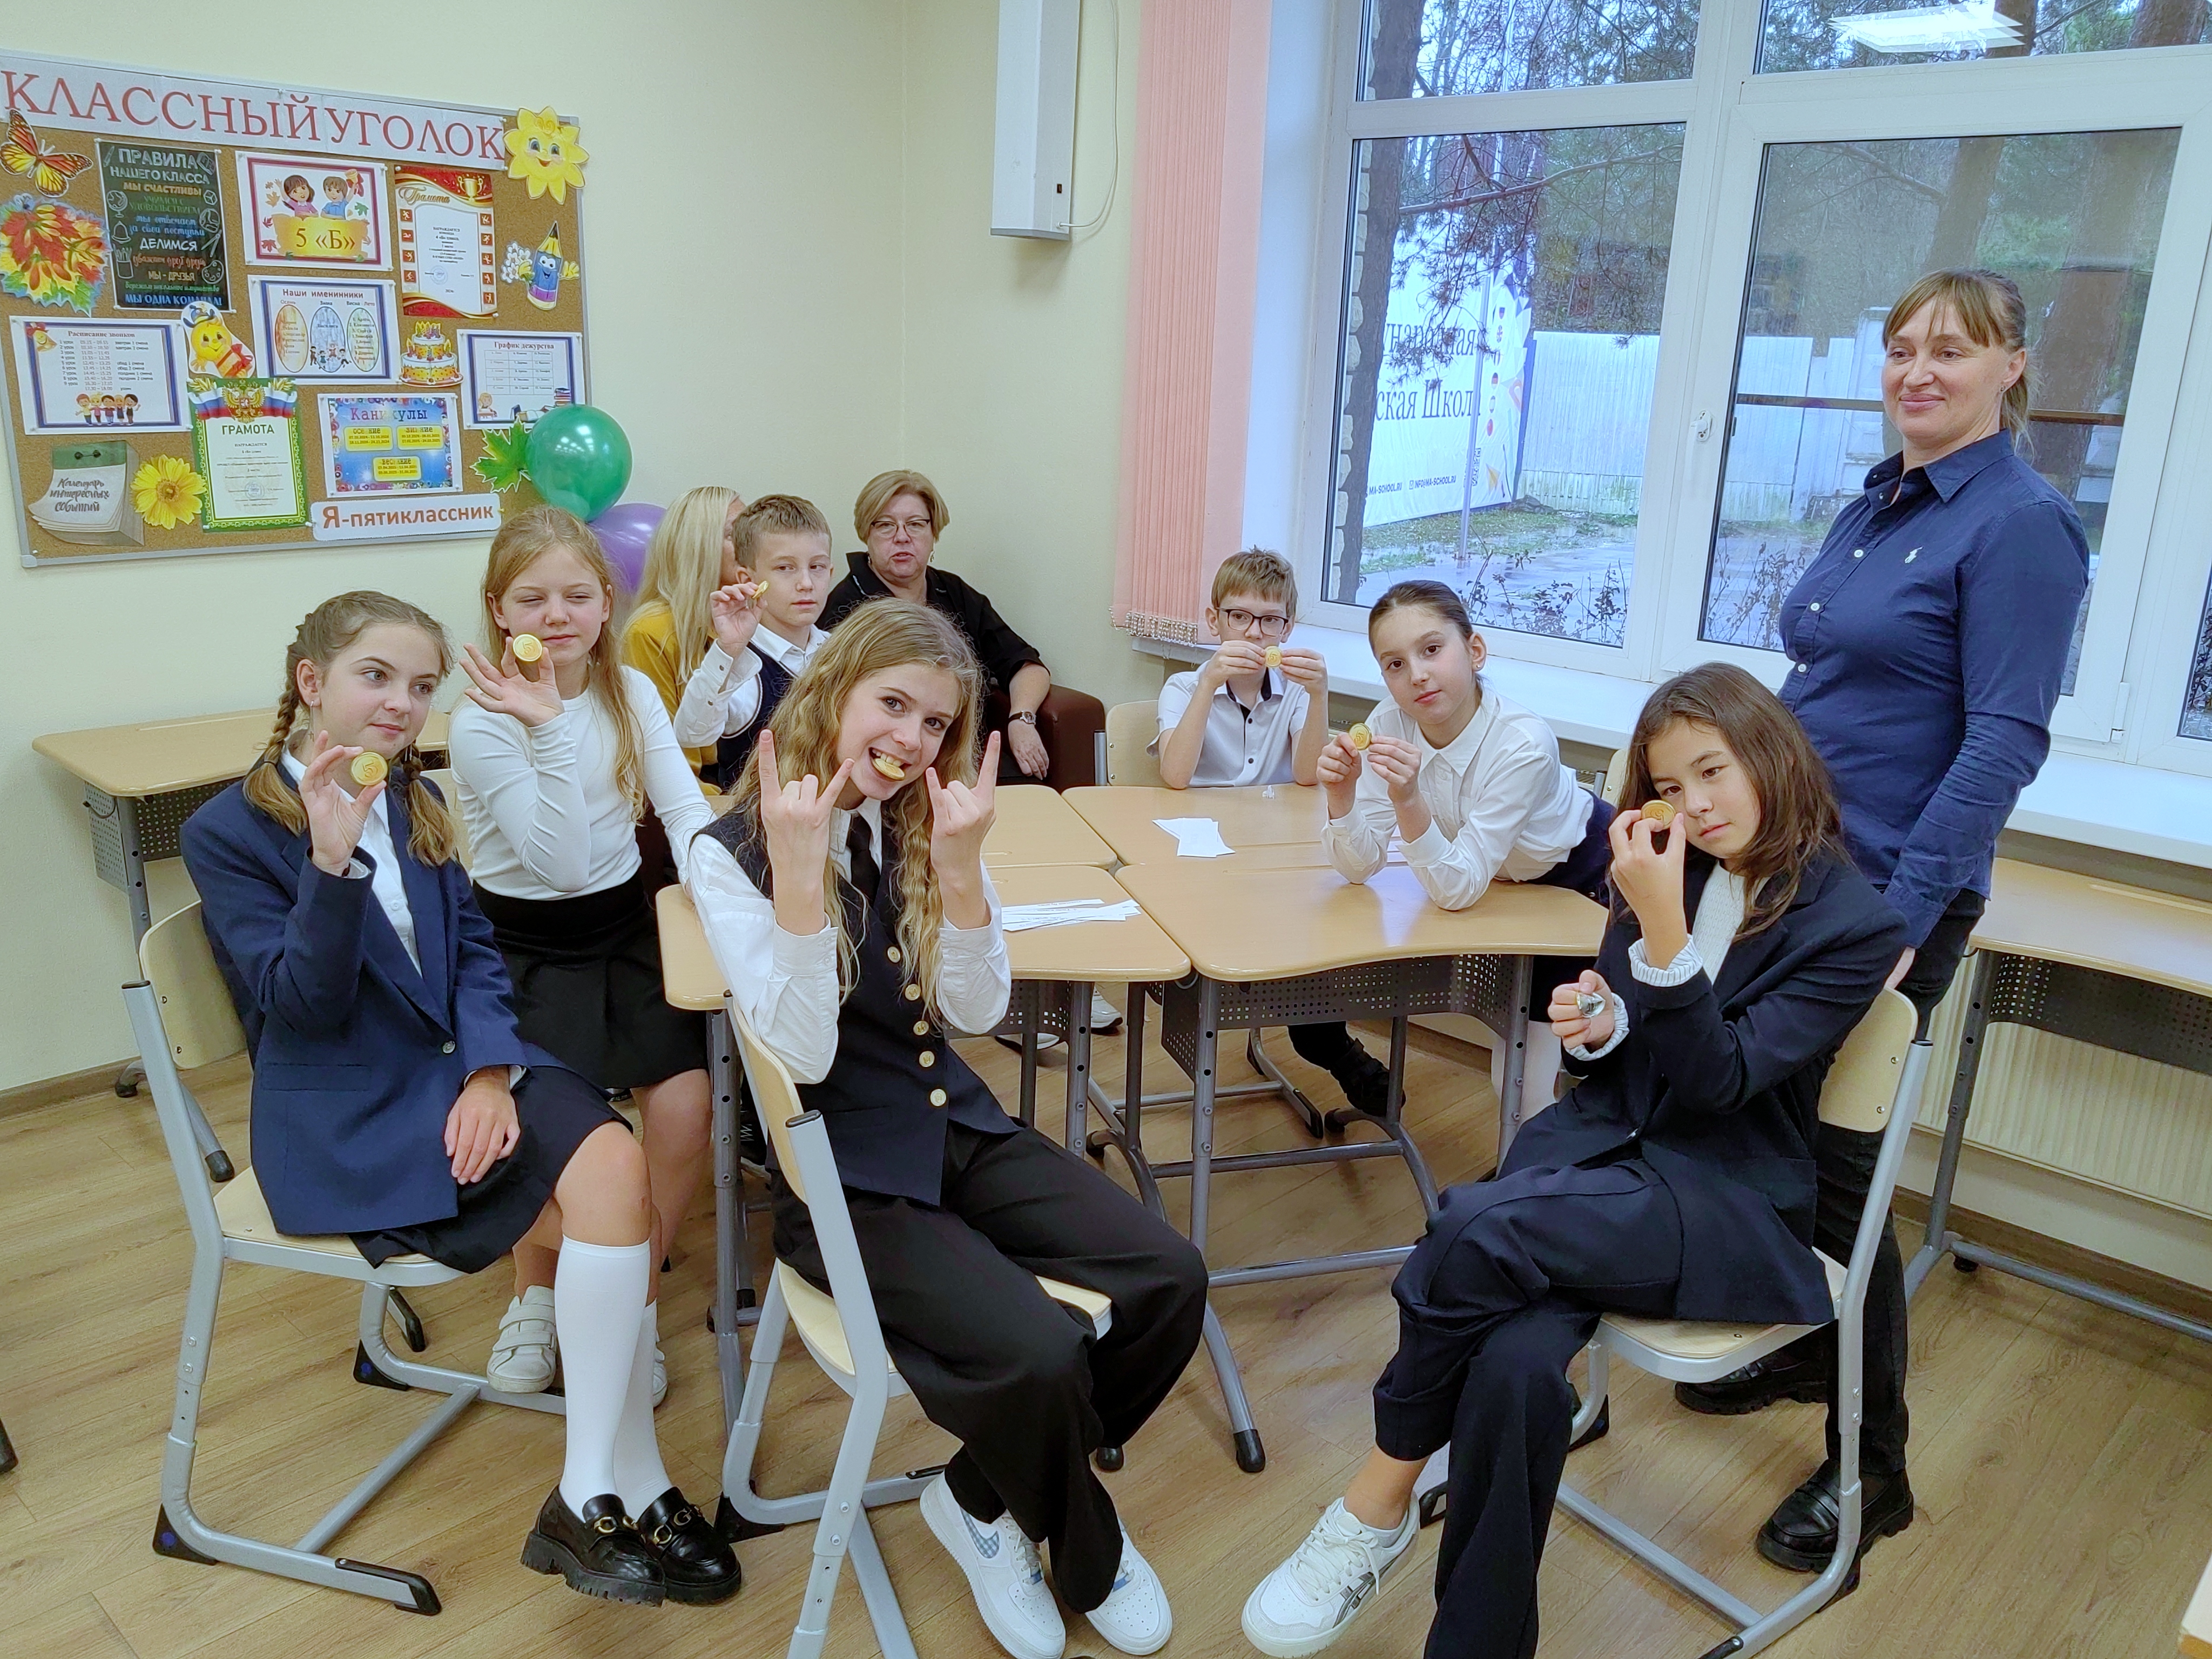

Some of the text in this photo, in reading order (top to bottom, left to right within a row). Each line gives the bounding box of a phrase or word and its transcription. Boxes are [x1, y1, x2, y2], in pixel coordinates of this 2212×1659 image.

[2, 70, 505, 160] КЛАССНЫЙ УГОЛОК
[118, 148, 199, 170] ПРАВИЛА
[110, 166, 210, 185] НАШЕГО КЛАССА
[123, 181, 202, 196] МЫ СЧАСТЛИВЫ
[139, 238, 198, 252] ДЕЛИМСЯ
[296, 228, 355, 251] 5 «Б»
[148, 271, 161, 280] МЫ
[168, 271, 195, 281] ДРУЗЬЯ
[282, 288, 307, 297] Наши
[125, 294, 142, 304] МЫ
[145, 294, 171, 305] ОДНА
[494, 341, 555, 351] График дежурства
[1421, 380, 1480, 419] Школ
[221, 424, 275, 435] ГРАМОТА
[57, 477, 105, 490] Календарь
[1368, 482, 1402, 495] MA-SCHOOL.RU
[50, 489, 110, 502] интересных
[55, 499, 100, 512] событий
[322, 505, 494, 529] Я-пятиклассник
